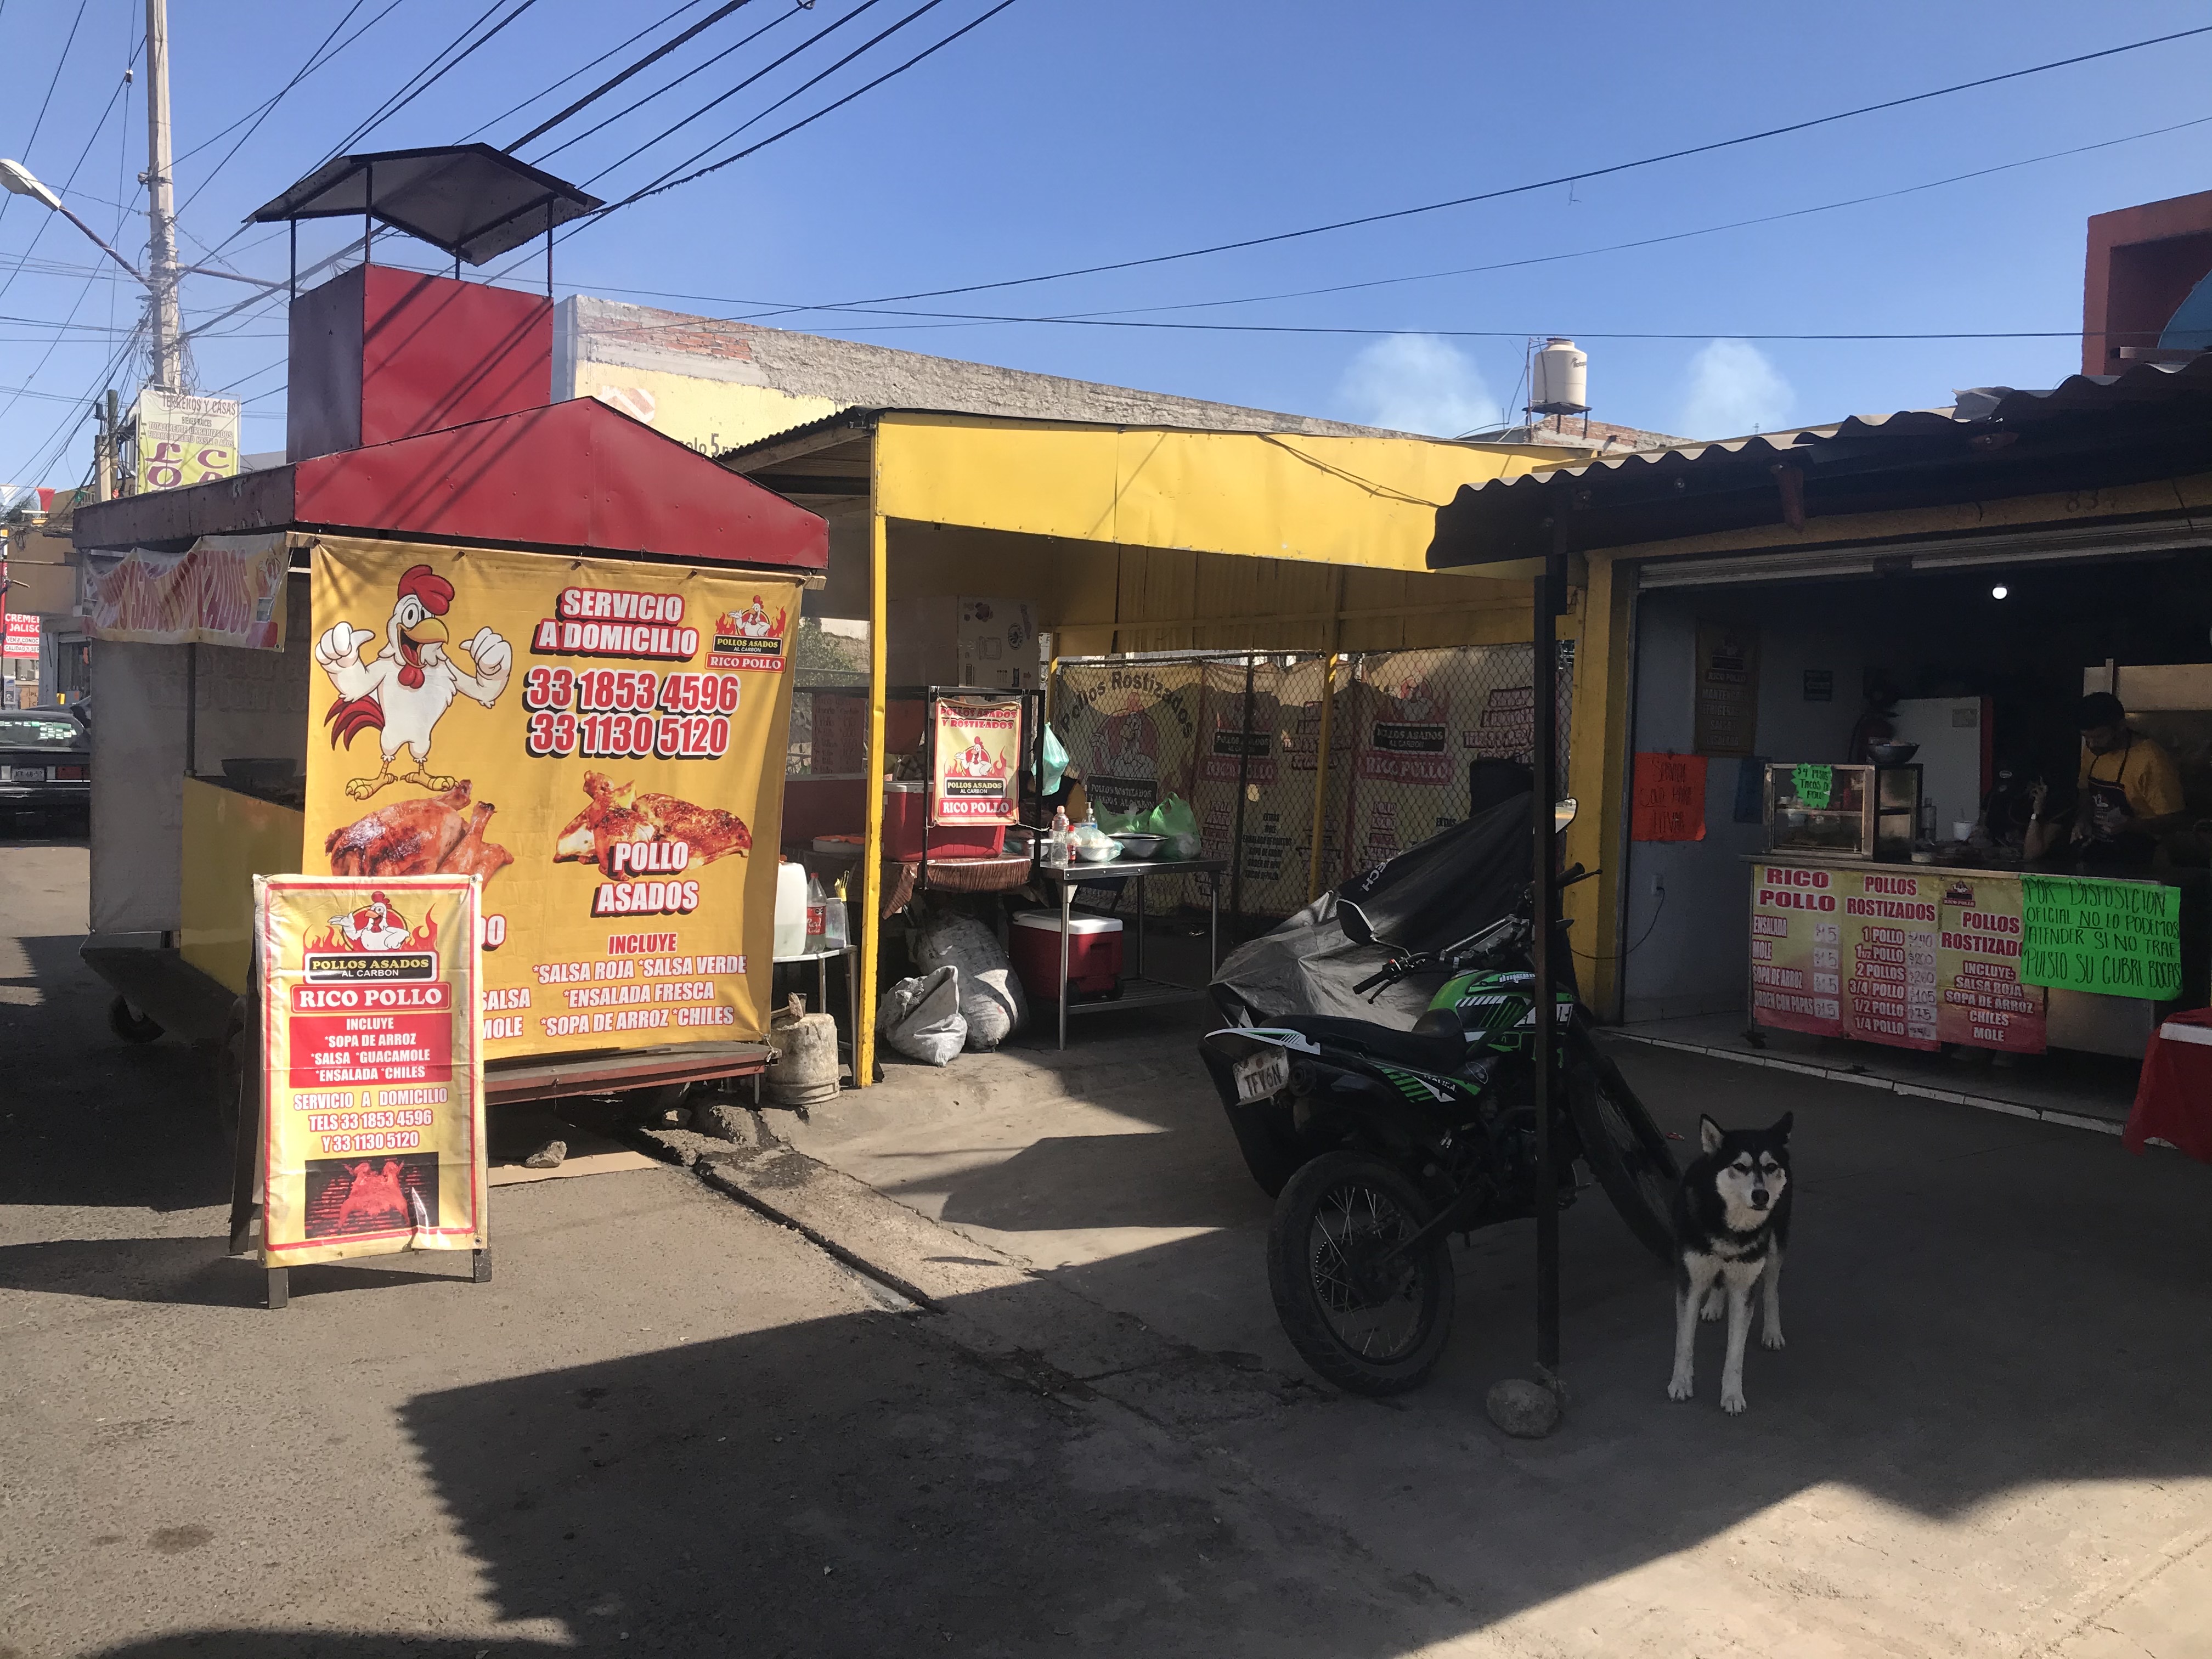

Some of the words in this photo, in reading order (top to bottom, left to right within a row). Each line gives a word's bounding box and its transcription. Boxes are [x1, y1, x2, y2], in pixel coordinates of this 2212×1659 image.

[204, 400, 210, 410] Y
[212, 400, 236, 416] CASAS
[711, 433, 719, 456] 5
[563, 589, 684, 623] SERVICIO
[538, 621, 558, 648] A
[563, 624, 698, 656] DOMICILIO
[717, 638, 747, 647] POLLOS
[748, 640, 778, 648] ASADOS
[710, 656, 740, 667] RICO
[742, 658, 781, 669] POLLO
[529, 668, 574, 708] 33
[579, 670, 657, 711] 1853
[661, 674, 740, 712] 4596
[940, 706, 975, 717] POLLOS
[977, 708, 1017, 719] ASADOS
[532, 713, 577, 753] 33
[582, 714, 654, 754] 1130
[659, 716, 730, 754] 5120
[941, 719, 948, 727] Y
[950, 719, 1014, 729] ROSTIZADOS
[943, 802, 968, 813] RICO
[970, 803, 1009, 813] POLLO
[614, 842, 689, 872] POLLO
[1767, 868, 1829, 888] RICO
[1865, 876, 1917, 896] POLLOS
[596, 881, 699, 913] ASADOS
[1760, 890, 1836, 912] POLLO
[2025, 878, 2056, 904] POR
[2069, 878, 2166, 917] DISPOSICION
[1847, 898, 1936, 922] ROSTIZADOS
[1753, 915, 1787, 938] ENSALADA
[1963, 911, 2020, 934] POLLOS
[2026, 907, 2073, 924] OFICIAL
[2079, 910, 2101, 927] NO
[2106, 913, 2120, 929] LO
[2125, 915, 2180, 939] PODEMOS
[608, 933, 678, 955] INCLUYE
[1862, 926, 1870, 942] 1
[1871, 927, 1905, 946] POLLO
[2027, 926, 2085, 945] ATENDER
[2094, 931, 2108, 950] SI
[2114, 934, 2138, 951] NO
[1753, 939, 1773, 961] MOLE
[1872, 945, 1905, 963] POLLO
[312, 961, 366, 969] POLLOS
[370, 960, 429, 968] ASADOS
[594, 960, 635, 979] ROJA
[697, 956, 747, 975] VERDE
[1855, 961, 1865, 977] 2
[1866, 962, 1906, 982] POLLOS
[1963, 960, 2016, 981] INCLUYE:
[2024, 947, 2068, 980] PUESTO
[2075, 953, 2094, 984] SU
[1753, 964, 1770, 985] SOPA
[1771, 966, 1780, 986] DE
[1780, 968, 1803, 990] ARROZ
[1955, 975, 1991, 993] SALSA
[1993, 981, 2024, 998] ROJA
[300, 990, 358, 1008] RICO
[364, 988, 442, 1006] POLLO
[654, 982, 714, 1003] FRESCA
[1848, 978, 1869, 996] 3/4
[1871, 981, 1905, 1000] POLLO
[1775, 992, 1791, 1013] CON
[1791, 995, 1814, 1015] PAPAS
[1853, 997, 1871, 1013] 1/2
[1871, 1000, 1904, 1018] POLLO
[1945, 990, 1976, 1006] SOPA
[1978, 994, 1993, 1008] DE
[1994, 997, 2034, 1014] ARROZ
[346, 1018, 394, 1031] INCLUYE
[593, 1014, 613, 1032] DE
[616, 1009, 669, 1030] ARROZ
[1854, 1015, 1872, 1031] 1/4
[1872, 1018, 1905, 1036] POLLO
[1969, 1009, 2010, 1027] CHILES
[362, 1035, 375, 1047] DE
[378, 1033, 416, 1046] ARROZ
[1973, 1026, 2005, 1042] MOLE
[294, 1093, 353, 1110] SERVICIO
[361, 1092, 371, 1107] A
[379, 1088, 448, 1106] DOMICILIO
[309, 1115, 338, 1132] TELS
[340, 1113, 359, 1130] 33
[362, 1111, 394, 1128] 1853
[397, 1109, 433, 1126] 4596
[321, 1136, 332, 1153] Y
[332, 1135, 352, 1152] 33
[353, 1132, 385, 1150] 1130
[386, 1131, 419, 1148] 5120
